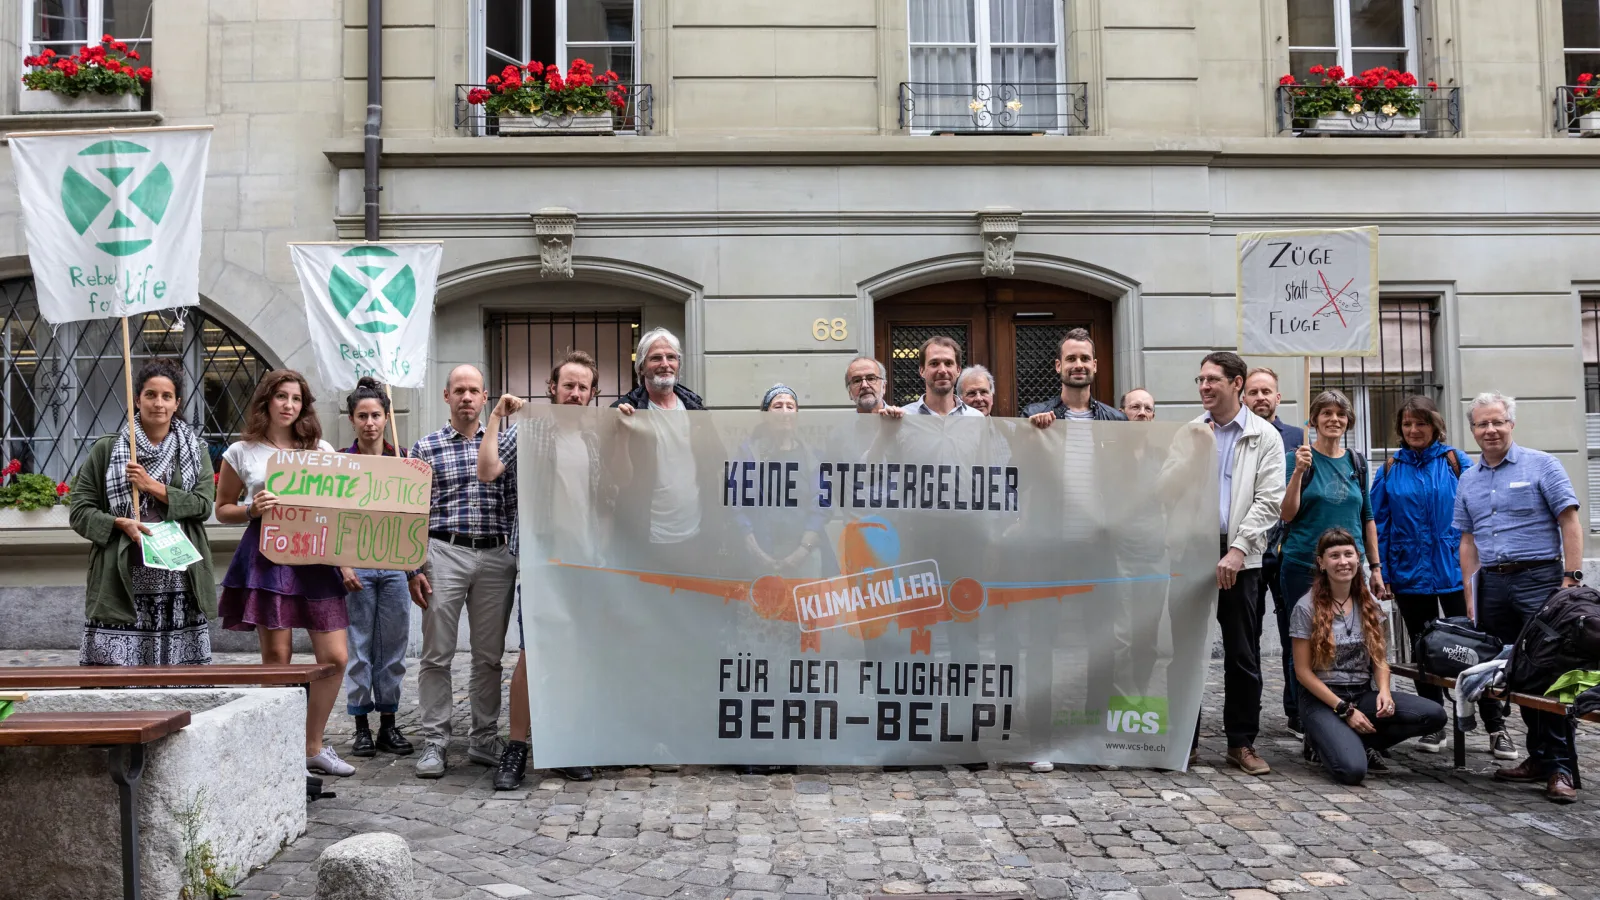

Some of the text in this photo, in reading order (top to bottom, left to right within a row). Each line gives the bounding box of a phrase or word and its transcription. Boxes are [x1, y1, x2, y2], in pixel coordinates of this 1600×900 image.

[1268, 242, 1333, 268] ZÜGE
[69, 264, 118, 288] Rebel
[124, 264, 167, 305] Life
[812, 317, 848, 341] 68
[1269, 311, 1321, 334] FLÜGE
[340, 340, 381, 361] Rebel
[388, 346, 411, 377] ife
[276, 451, 361, 470] INVEST in
[359, 472, 428, 507] JUSTICE
[723, 461, 1019, 511] KEINE STEUERGELDER
[271, 507, 327, 524] NOT in
[335, 512, 427, 565] FOOLS
[799, 571, 938, 621] KLIMA-KILLER
[1443, 647, 1467, 658] NORTH
[1448, 654, 1465, 663] FACE
[1455, 644, 1469, 654] THE
[719, 652, 1014, 698] FÜR DEN FLUGHAFEN
[1105, 742, 1166, 753] www.vcs-be.ch
